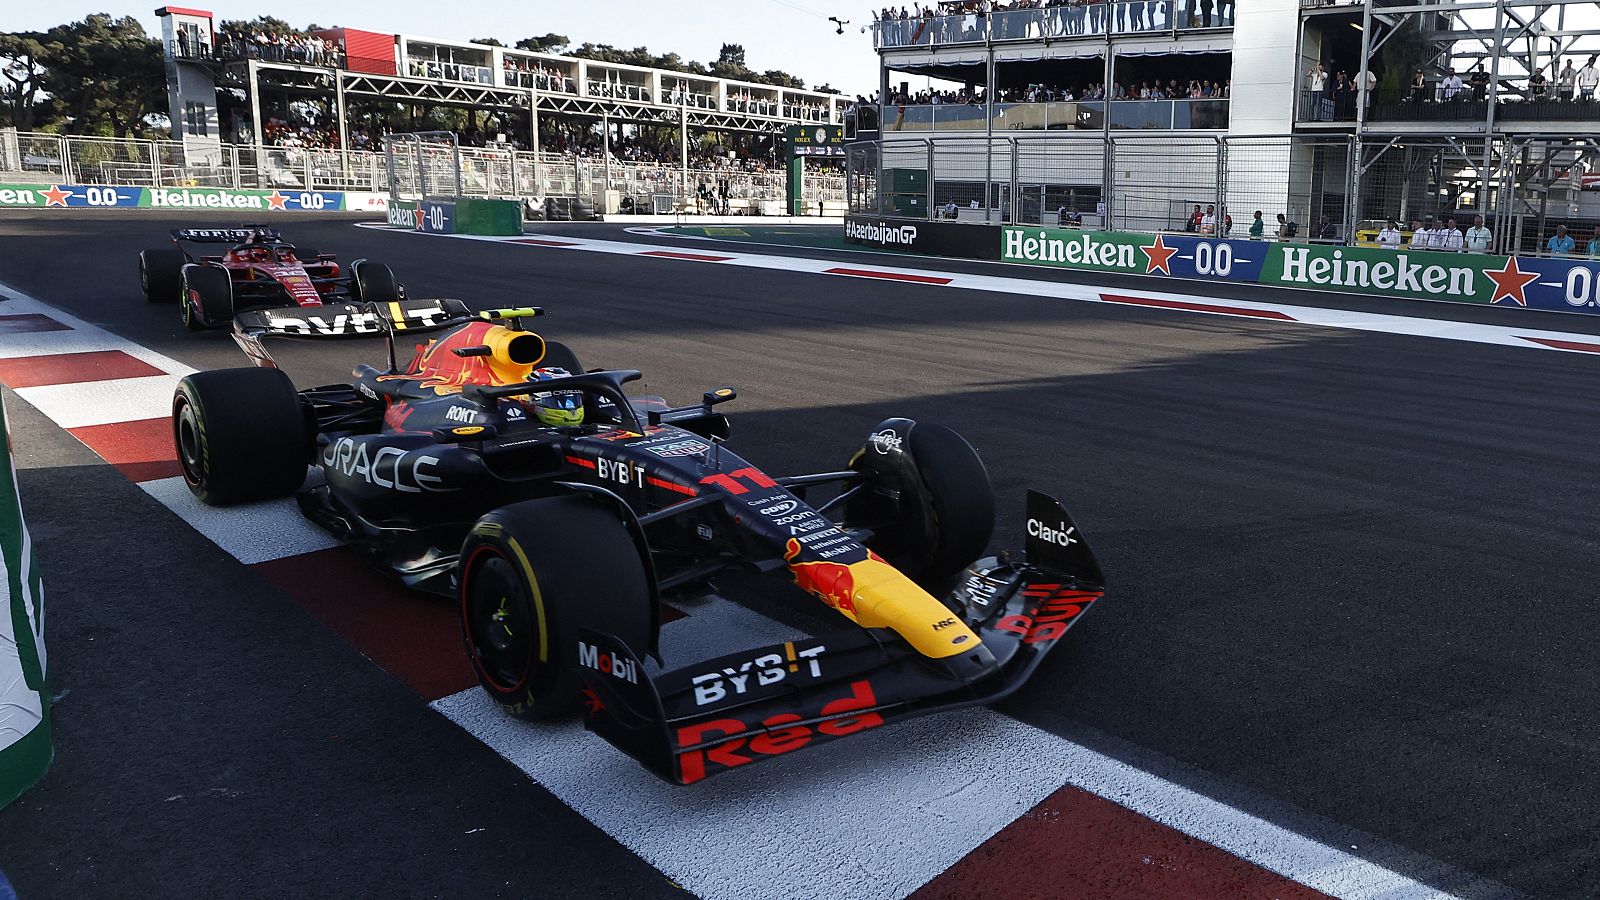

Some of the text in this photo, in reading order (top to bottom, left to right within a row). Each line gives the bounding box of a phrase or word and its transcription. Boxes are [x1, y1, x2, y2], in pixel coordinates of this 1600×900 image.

[150, 187, 263, 209] Heineken
[845, 220, 917, 245] #AzerbaijanGP
[1004, 229, 1137, 268] Heineken
[1195, 242, 1233, 276] 0.0
[1280, 247, 1476, 296] Heineken
[445, 405, 478, 424] ROKT
[698, 467, 779, 495] 11
[747, 494, 788, 507] Cash App
[760, 502, 791, 516] CDW
[772, 510, 816, 526] zoom
[1026, 518, 1071, 548] Claro
[819, 544, 852, 559] Mobil
[578, 641, 639, 685] Mobil
[676, 679, 885, 785] Red
